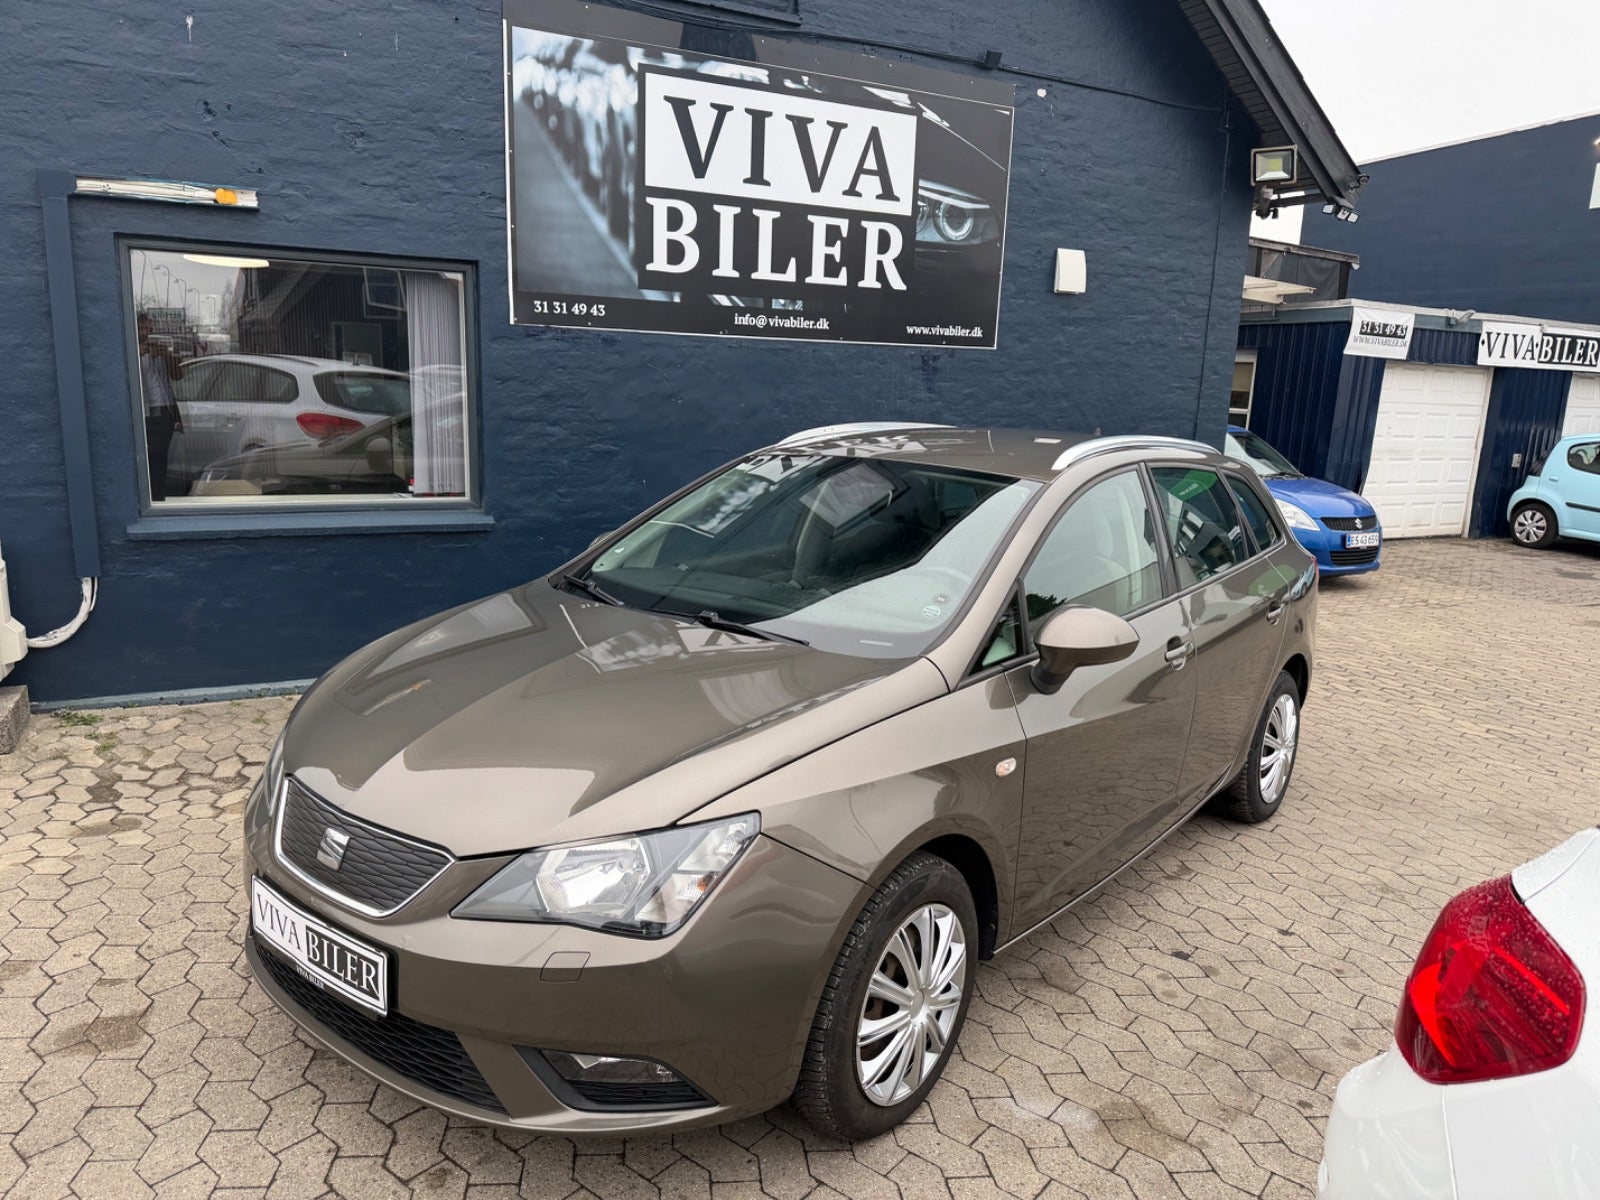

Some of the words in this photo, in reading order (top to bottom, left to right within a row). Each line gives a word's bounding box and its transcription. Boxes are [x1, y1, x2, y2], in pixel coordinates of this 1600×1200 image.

[663, 95, 901, 203] VIVA
[645, 196, 907, 291] BILER
[533, 300, 549, 313] 31
[552, 301, 568, 314] 31
[571, 302, 587, 315] 49
[589, 303, 606, 316] 43
[906, 325, 983, 338] www.vivabiler.dk
[1361, 320, 1371, 333] 31
[1373, 321, 1384, 334] 31
[1384, 323, 1396, 335] 49
[1485, 331, 1536, 361] VIVA
[1539, 335, 1599, 366] BILER
[257, 893, 303, 953] VIVA
[306, 929, 381, 1000] BILER
